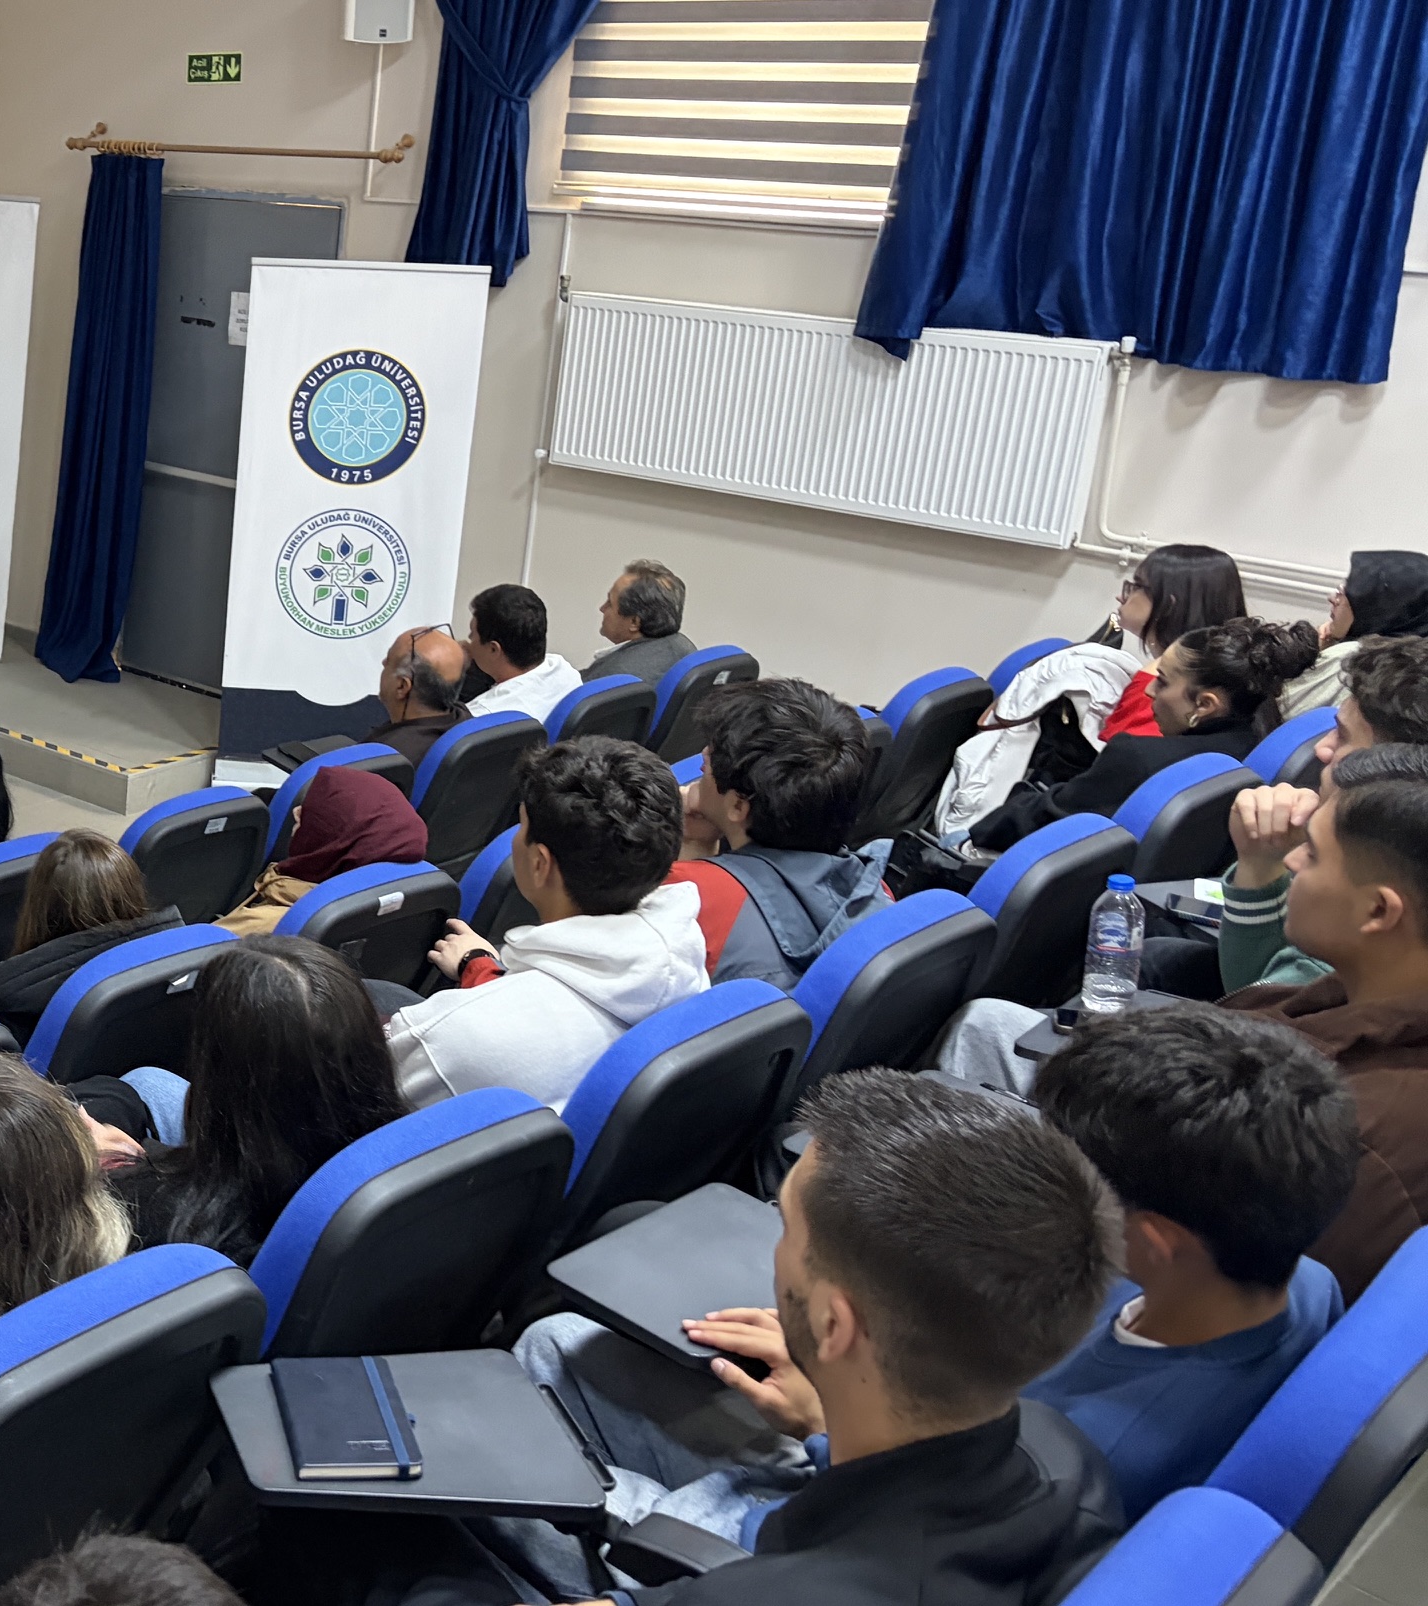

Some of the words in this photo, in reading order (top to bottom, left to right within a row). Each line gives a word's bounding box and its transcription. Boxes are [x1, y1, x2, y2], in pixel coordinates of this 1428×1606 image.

[292, 390, 310, 442] BURSA
[305, 351, 366, 388] ULUDAĞ
[330, 467, 373, 482] 1975
[282, 529, 309, 561] BURSA
[307, 511, 351, 532] ULUDAĞ
[353, 513, 408, 566] ÜNİVERSİTESİ
[278, 566, 315, 630] BÜYÜKORHAN
[314, 624, 357, 638] MESLEK
[357, 570, 408, 634] YÜKSEKOKULU
